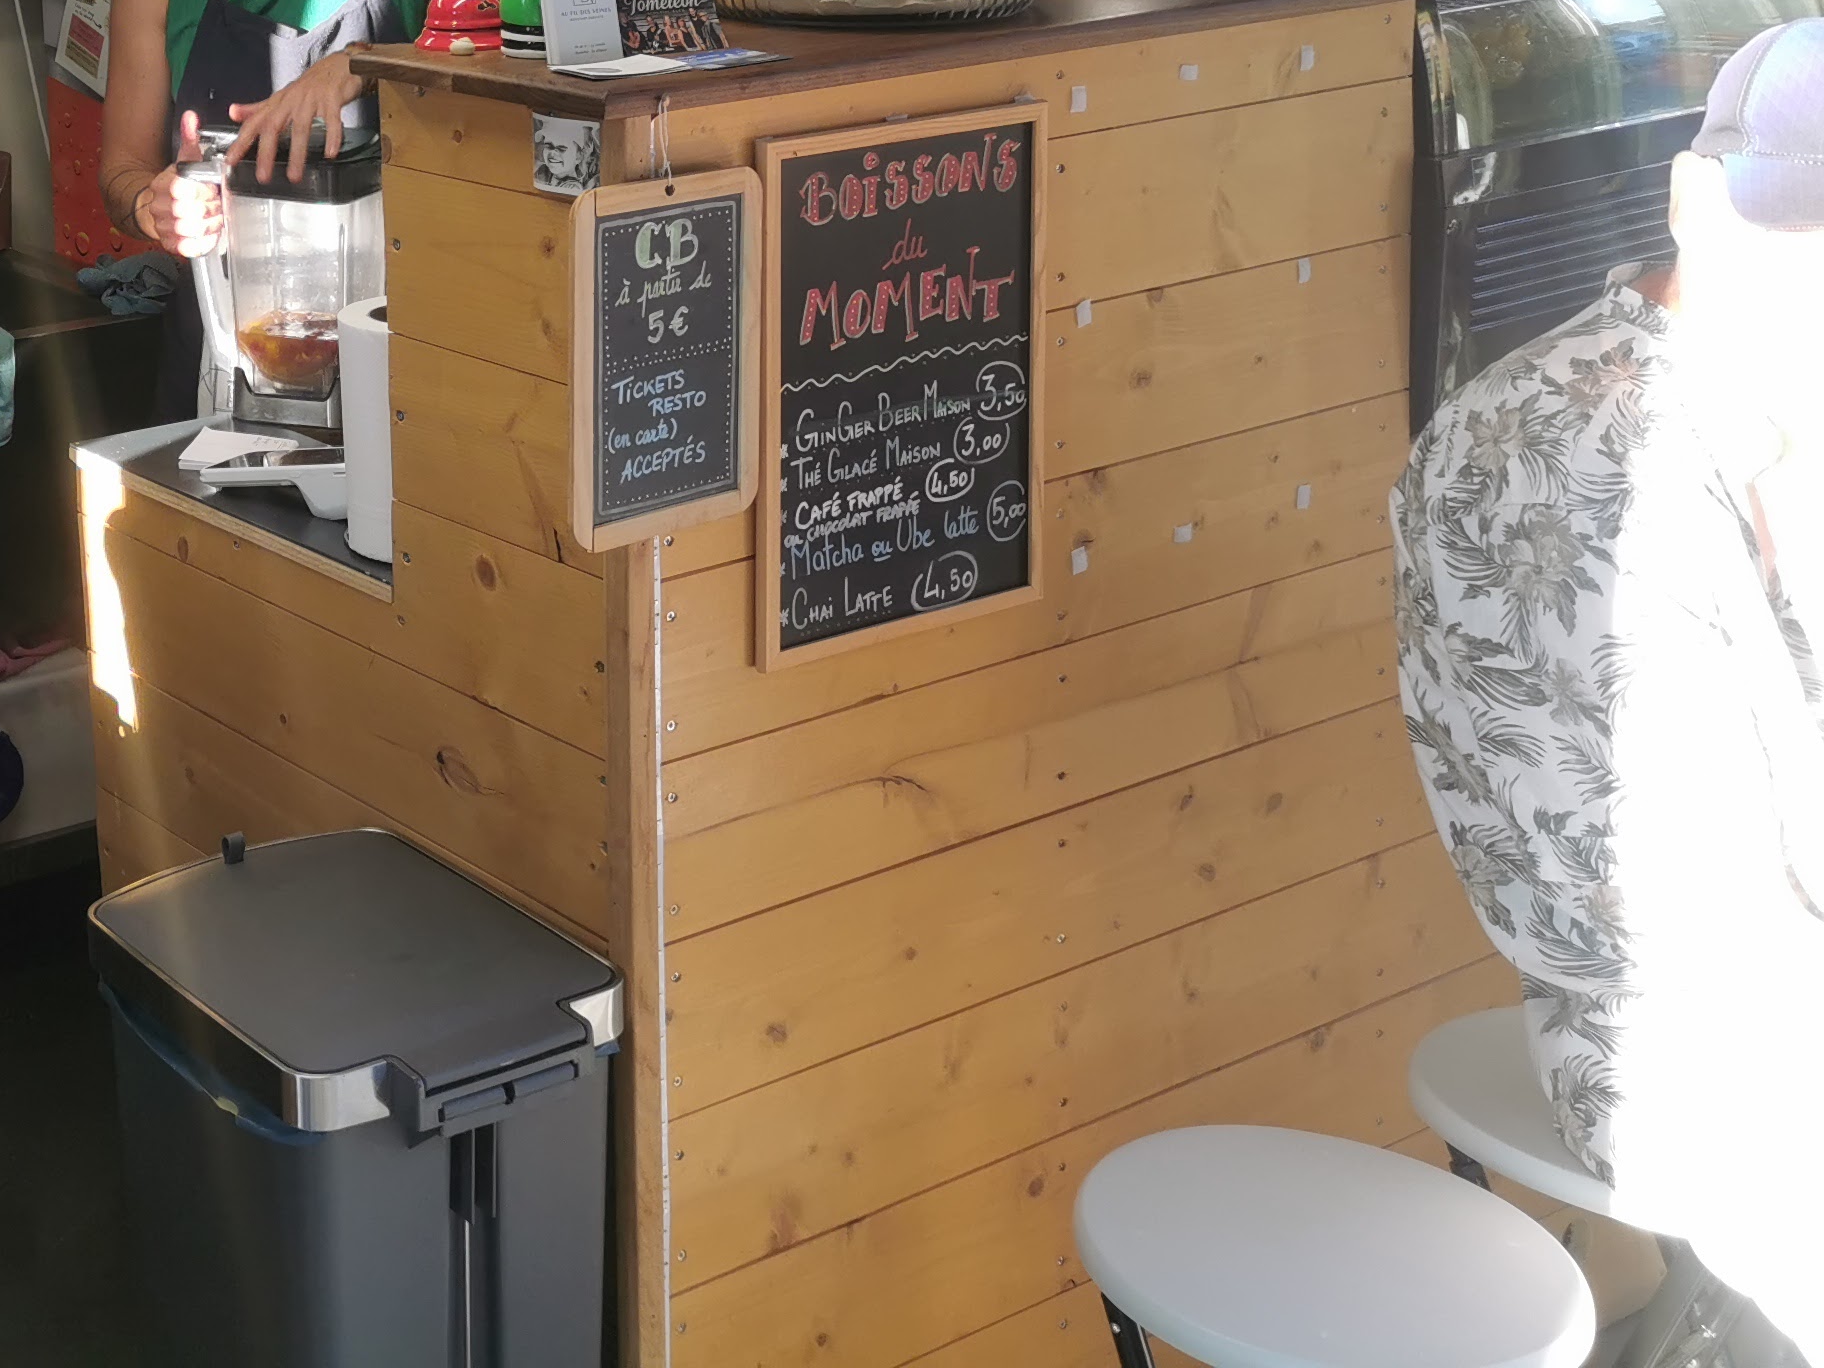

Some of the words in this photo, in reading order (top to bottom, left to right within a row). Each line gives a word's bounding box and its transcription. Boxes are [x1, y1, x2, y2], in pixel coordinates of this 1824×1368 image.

[634, 218, 700, 270] CB
[882, 218, 928, 271] du
[614, 279, 631, 308] à
[689, 261, 712, 290] de
[799, 244, 1016, 351] MOMENT
[647, 390, 707, 418] RESTO
[878, 392, 922, 432] BEER
[619, 435, 706, 485] ACCEPTÉS
[790, 456, 822, 490] THÉ
[795, 491, 842, 530] CAFÉ
[847, 475, 904, 512] FRAPPÉ
[876, 491, 921, 524] FRAPPÉ
[790, 533, 864, 580] Matcha
[871, 540, 893, 562] ou
[844, 576, 893, 617] LATTE
